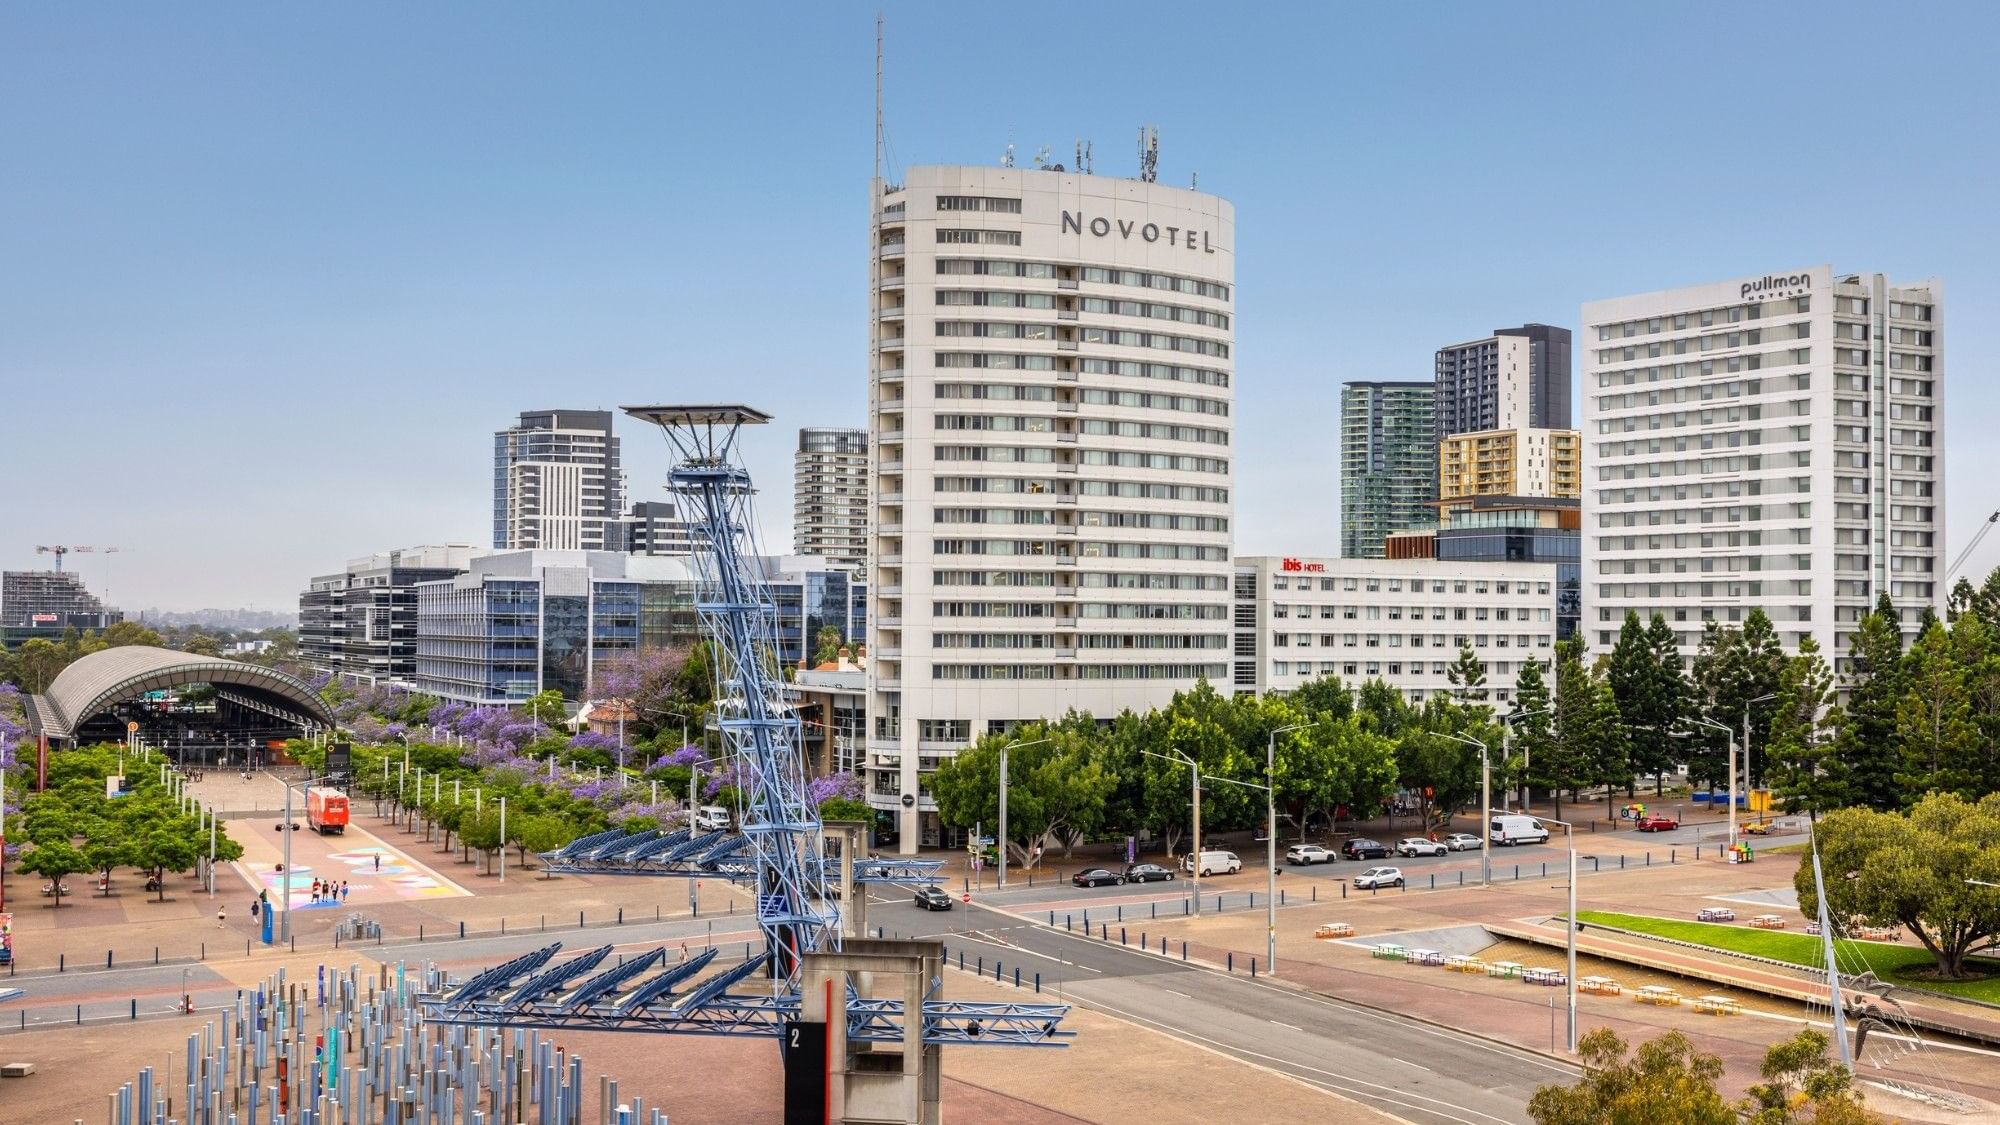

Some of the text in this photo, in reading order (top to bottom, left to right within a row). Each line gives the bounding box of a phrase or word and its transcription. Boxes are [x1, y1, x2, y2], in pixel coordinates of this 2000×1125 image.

[1061, 210, 1215, 254] NOVOTEL
[1741, 273, 1811, 299] pullman
[1748, 288, 1803, 301] HOTELS
[1283, 558, 1325, 572] ibis HOTEL
[163, 740, 168, 749] 2
[251, 739, 256, 748] 3
[791, 1028, 800, 1048] 2
